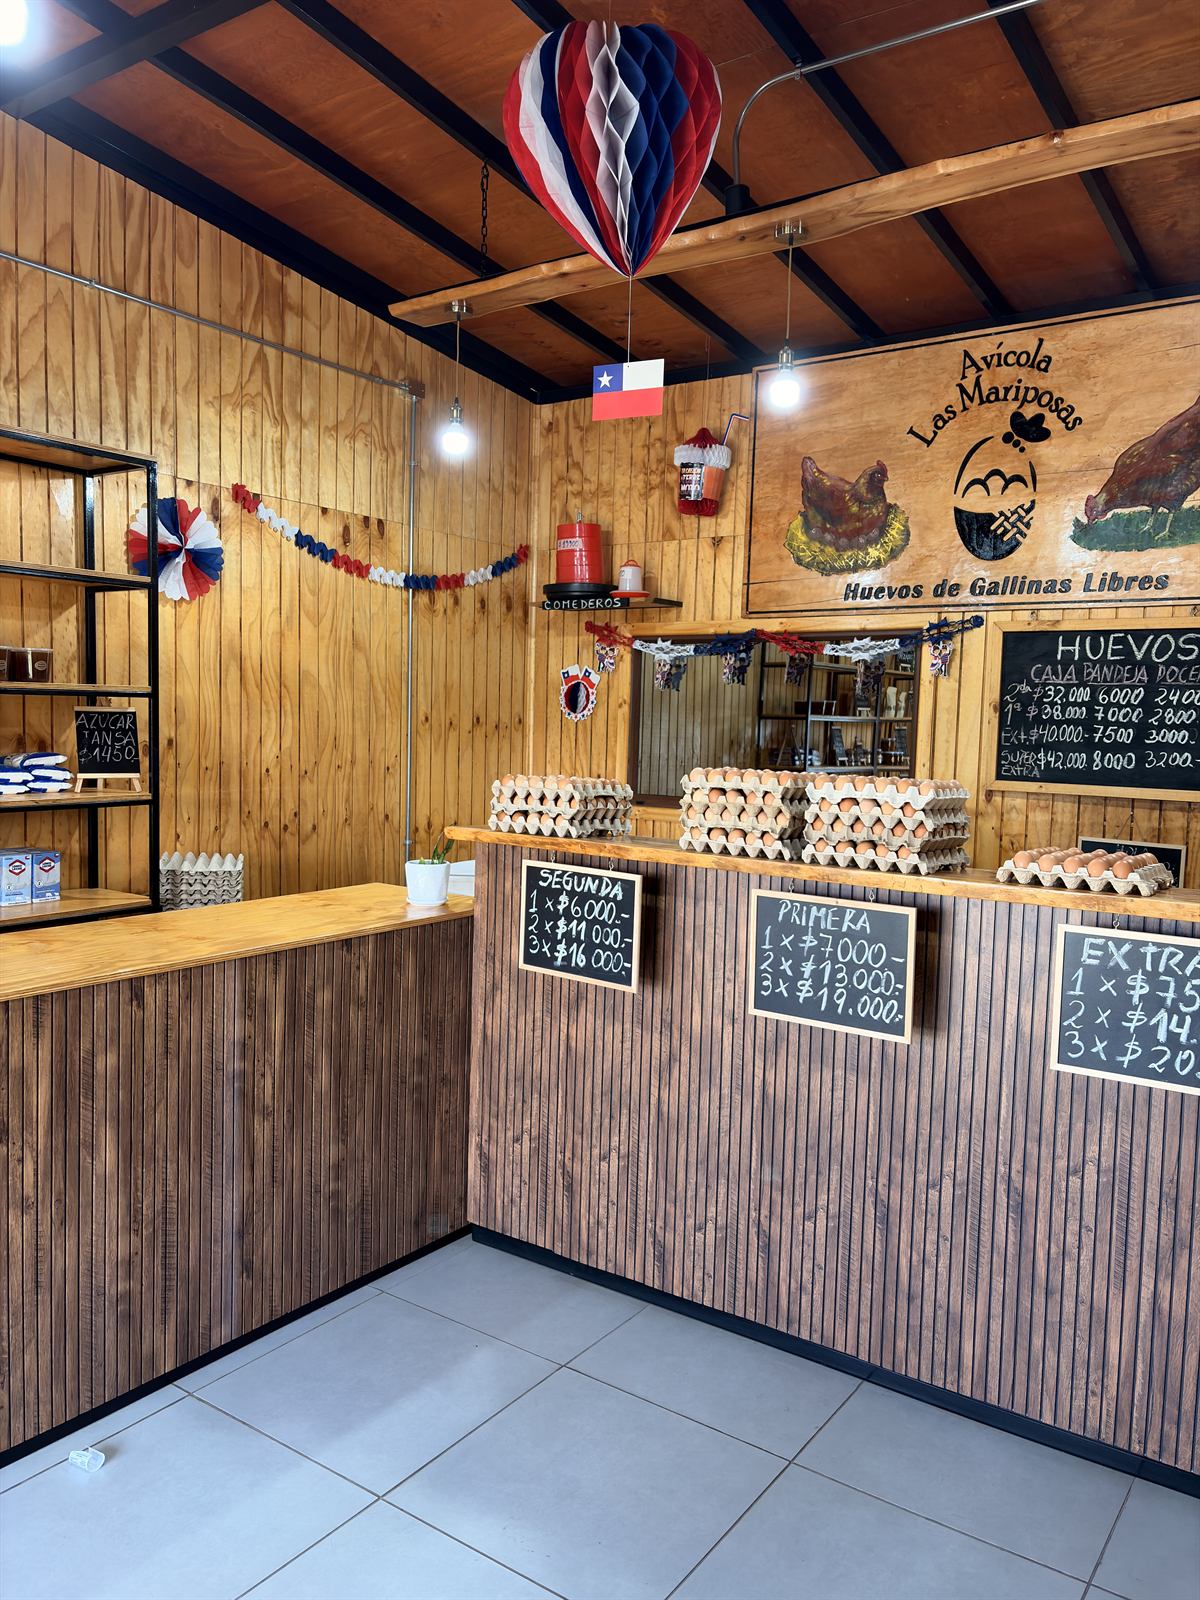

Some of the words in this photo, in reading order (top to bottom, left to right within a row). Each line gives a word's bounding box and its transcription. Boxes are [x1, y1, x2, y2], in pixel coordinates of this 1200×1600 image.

[961, 337, 1052, 380] Avícola
[907, 403, 957, 448] Las
[955, 375, 1082, 431] Mariposas
[844, 582, 923, 601] Huevos
[933, 578, 961, 598] de
[969, 576, 1072, 597] Gallinas
[1083, 571, 1170, 593] Libres
[544, 597, 621, 610] COMEDEROS
[1056, 633, 1200, 663] HUEVOS
[1030, 664, 1077, 682] CAJA
[1083, 662, 1149, 683] BANDEJA
[1155, 664, 1200, 683] DOCE
[1098, 687, 1144, 705] 6000
[1094, 706, 1143, 723] 7000
[1093, 725, 1134, 743] 7500
[1001, 749, 1037, 767] SUPER
[1092, 750, 1136, 770] 8000
[538, 868, 624, 901] SEGUNDA
[528, 889, 539, 912] 1
[528, 914, 539, 934] 2
[777, 899, 871, 934] PRIMERA
[528, 935, 540, 954] 3
[761, 925, 773, 949] 1
[760, 951, 773, 972] 2
[760, 973, 772, 996] 3
[1066, 967, 1085, 996] 1
[1062, 999, 1085, 1030] 2
[1064, 1030, 1085, 1059] 3
